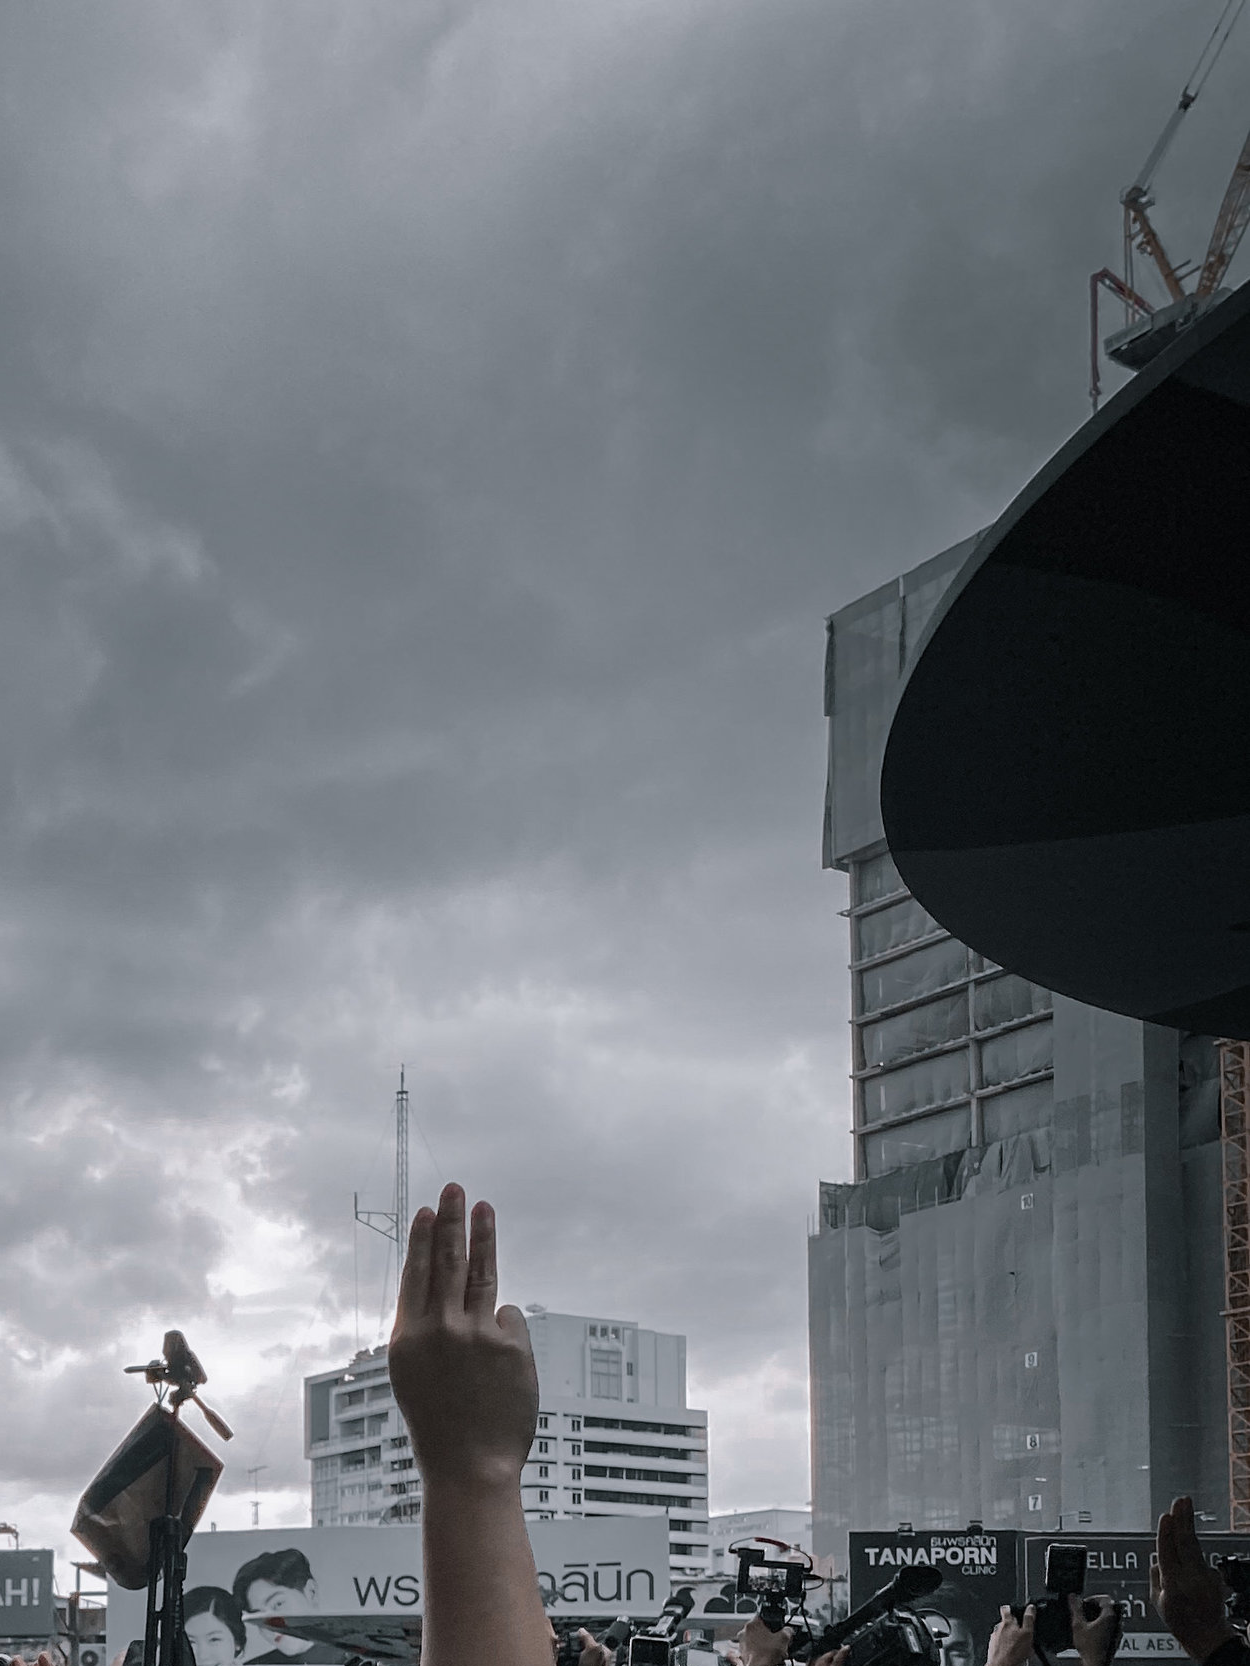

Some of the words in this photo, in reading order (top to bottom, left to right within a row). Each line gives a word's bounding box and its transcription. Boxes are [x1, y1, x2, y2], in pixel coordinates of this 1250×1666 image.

[864, 1547, 997, 1566] TANAPORN
[1086, 1552, 1138, 1569] ELLA
[961, 1565, 997, 1576] CLINIC
